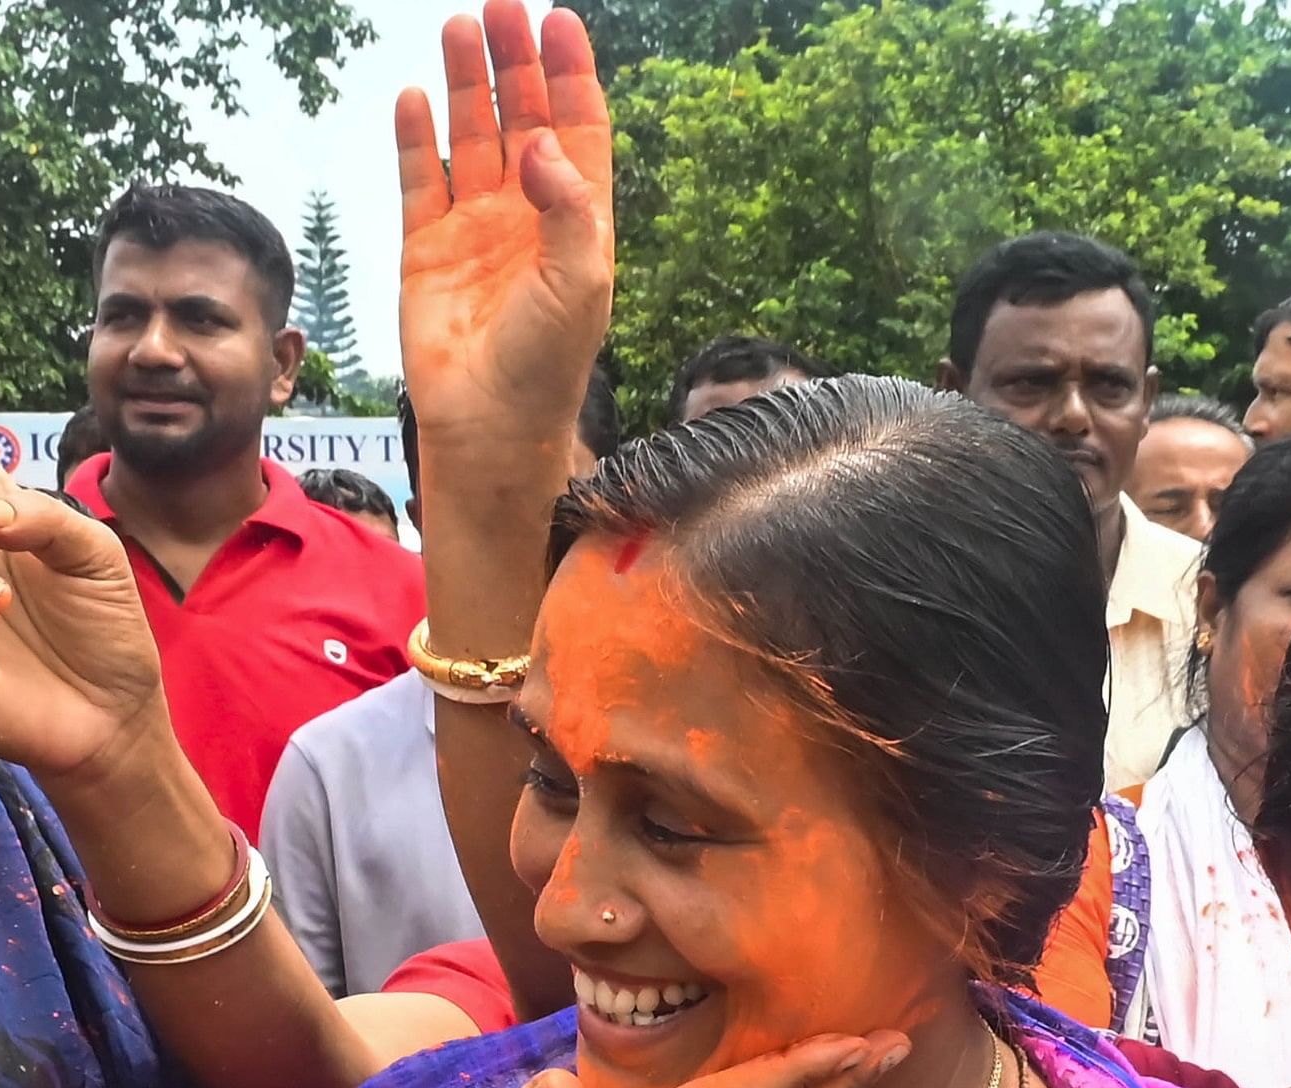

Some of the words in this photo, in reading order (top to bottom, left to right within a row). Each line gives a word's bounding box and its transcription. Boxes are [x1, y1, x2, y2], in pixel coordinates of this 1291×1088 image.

[30, 432, 61, 461] IC
[263, 434, 367, 462] RSITY
[376, 435, 398, 462] T
